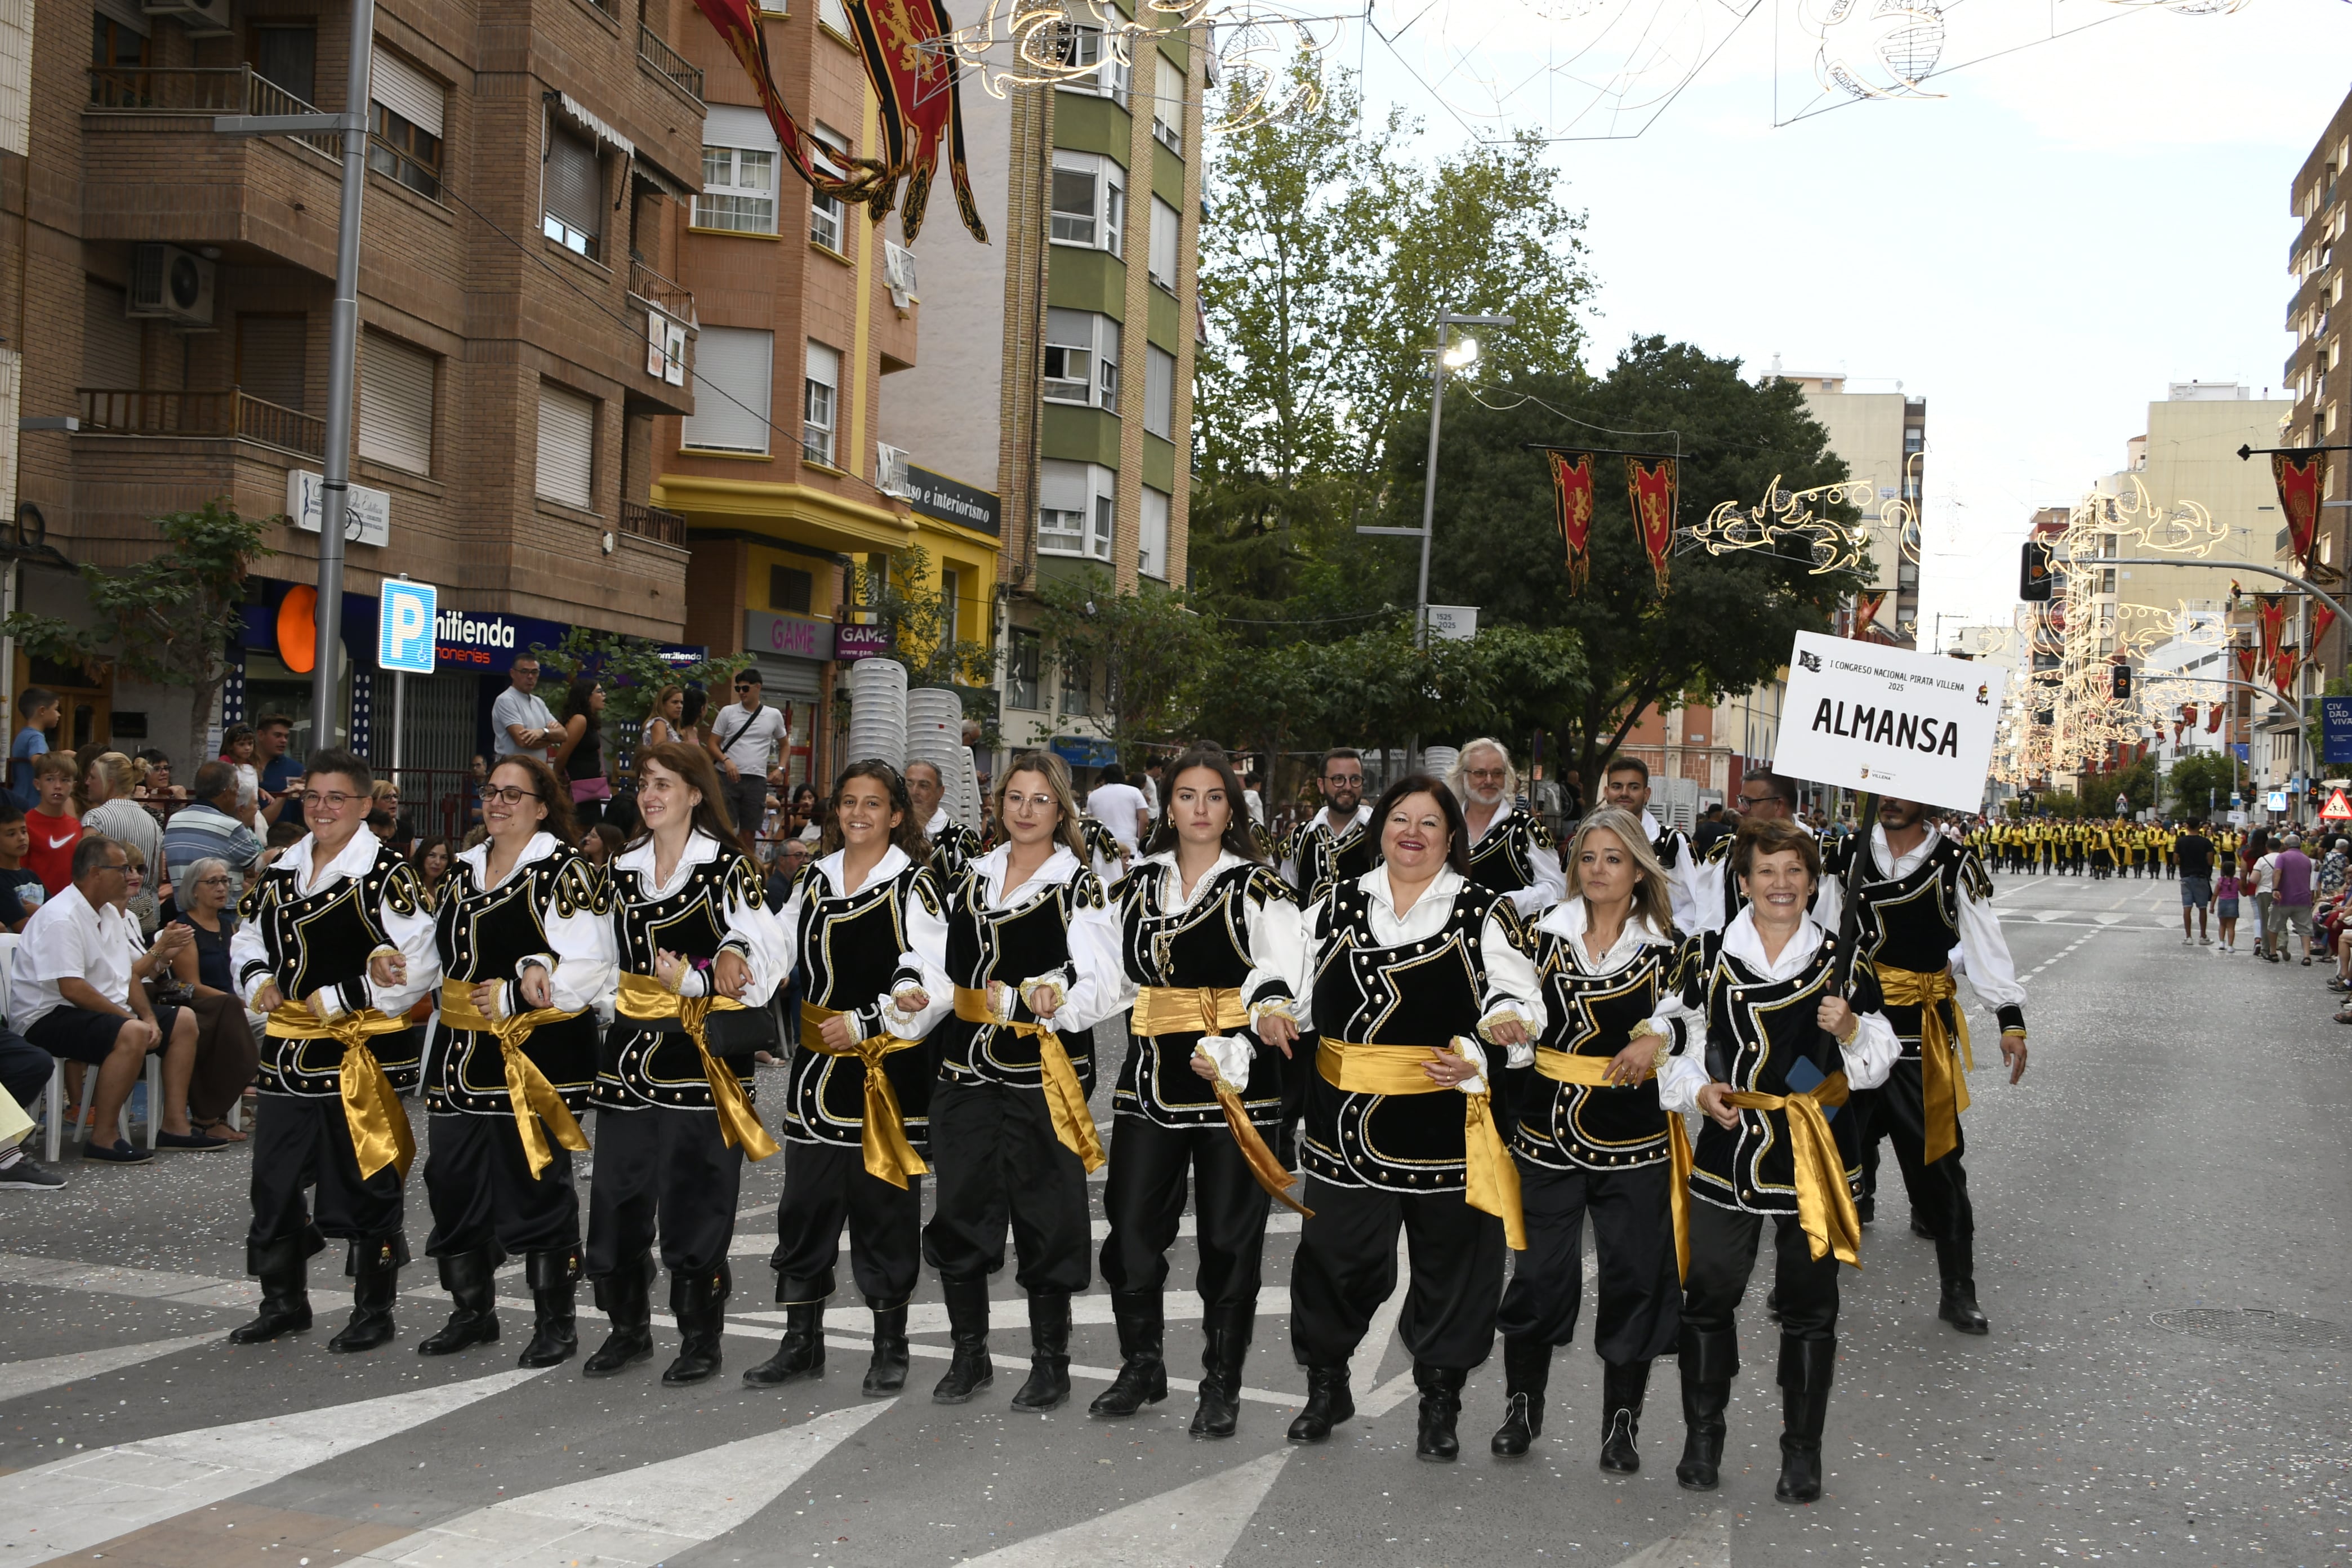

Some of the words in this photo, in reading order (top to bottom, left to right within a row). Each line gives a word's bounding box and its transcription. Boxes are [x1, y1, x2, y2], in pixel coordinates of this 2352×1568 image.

[924, 490, 930, 504] e
[933, 486, 989, 523] interiorismo
[391, 593, 425, 658] P
[772, 620, 815, 654] GAME
[1835, 661, 1872, 675] CONGRESO
[1874, 668, 1908, 681] NACIONAL
[1910, 675, 1933, 686] PIRATA
[1936, 679, 1965, 692] VILLENA
[1888, 683, 1904, 692] 2025
[1812, 698, 1957, 758] ALMANSA
[1872, 772, 1891, 781] VILLENA
